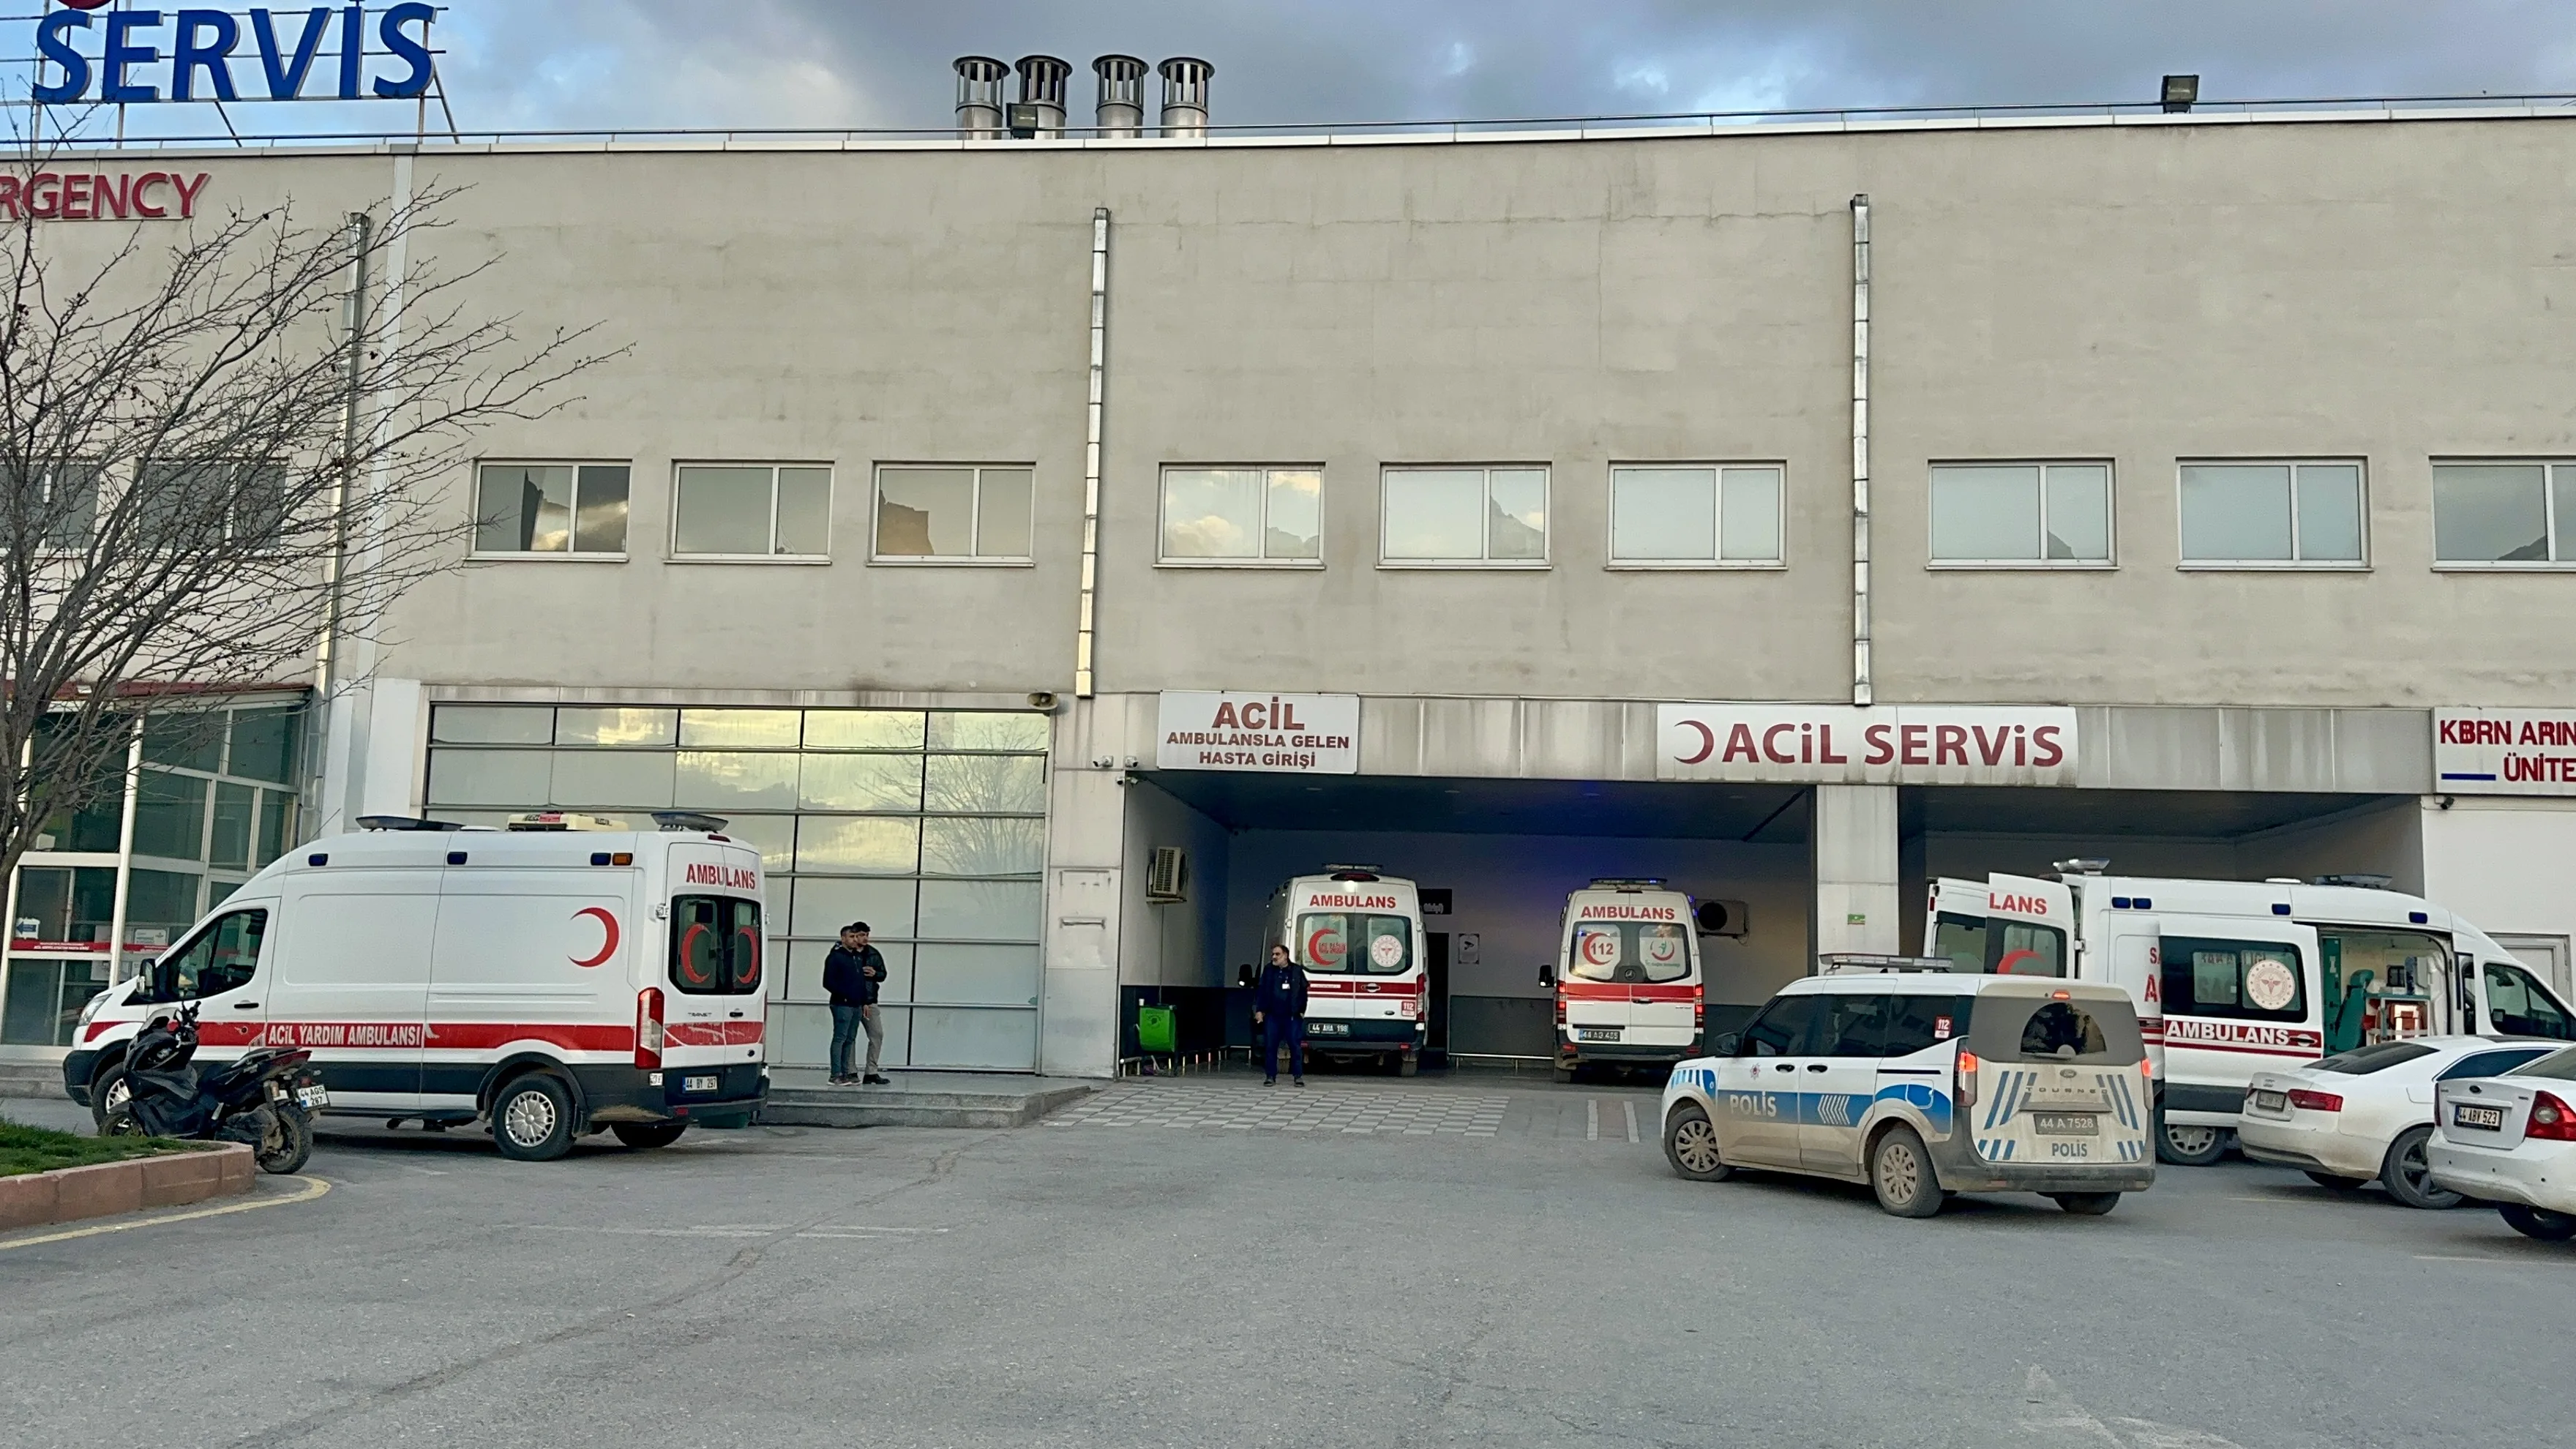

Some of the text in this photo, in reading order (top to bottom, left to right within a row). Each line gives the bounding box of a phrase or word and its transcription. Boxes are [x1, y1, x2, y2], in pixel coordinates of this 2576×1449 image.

[1212, 696, 1305, 730] ACİL
[1167, 732, 1349, 749] AMBULANSLA GELEN
[2440, 720, 2512, 745] KBRN
[1199, 750, 1316, 769] HASTA GİRİŞİ
[686, 864, 755, 890] AMBULANS
[1309, 894, 1396, 909] AMBULANS
[1989, 892, 2048, 916] LANS
[1581, 905, 1675, 920] AMBULANS
[1590, 943, 1614, 955] 112
[1404, 1003, 1414, 1011] 112
[1938, 1018, 1950, 1030] 112
[299, 1025, 345, 1045] YARDIM
[348, 1025, 421, 1046] AMBULANSI
[2166, 1020, 2291, 1046] AMBULANS
[686, 1078, 693, 1089] 44
[1729, 1090, 1777, 1117] POLİS
[2040, 1117, 2094, 1128] 44 A 7528
[2482, 1110, 2497, 1125] 523
[2051, 1139, 2088, 1157] POLİS
